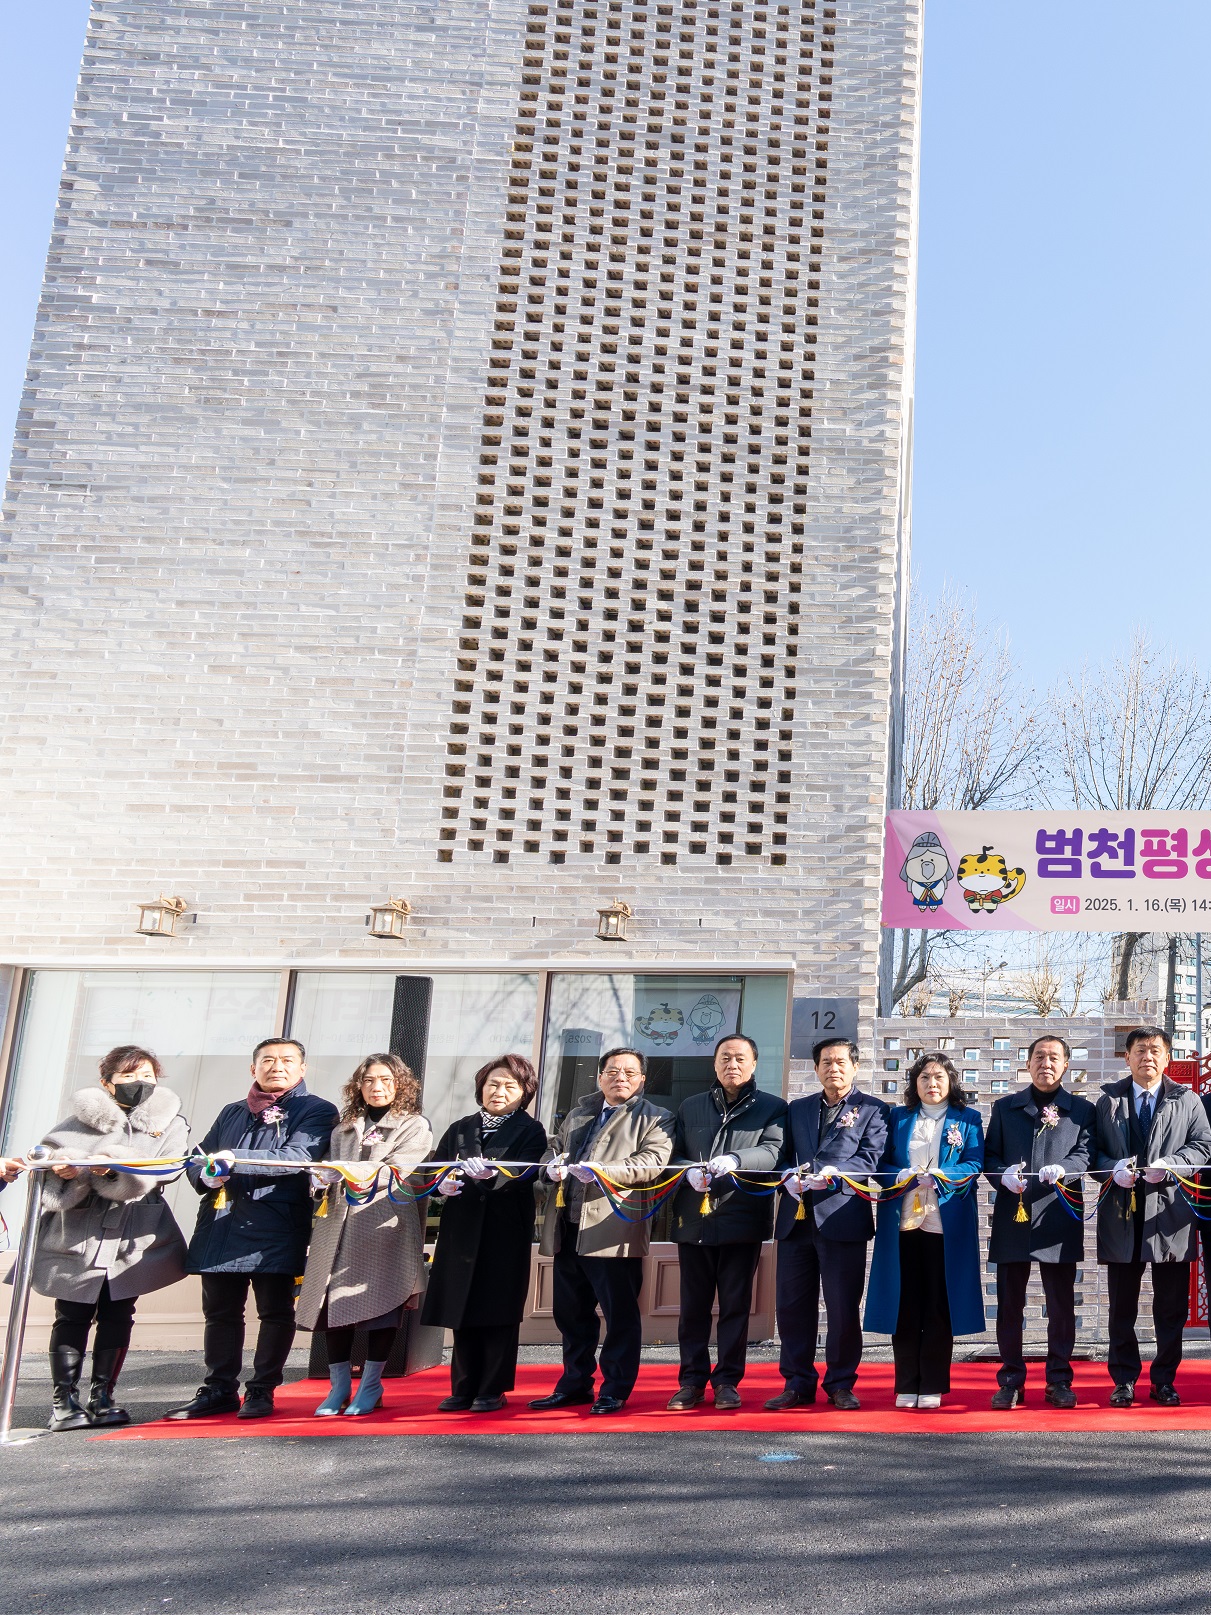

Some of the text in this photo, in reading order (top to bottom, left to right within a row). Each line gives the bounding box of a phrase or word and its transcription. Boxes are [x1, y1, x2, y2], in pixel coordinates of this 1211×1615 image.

[1053, 898, 1077, 913] 일시
[1084, 898, 1122, 912] 2025.
[1127, 899, 1139, 912] 1.
[1144, 897, 1187, 913] 16.(목)
[811, 1010, 836, 1030] 12
